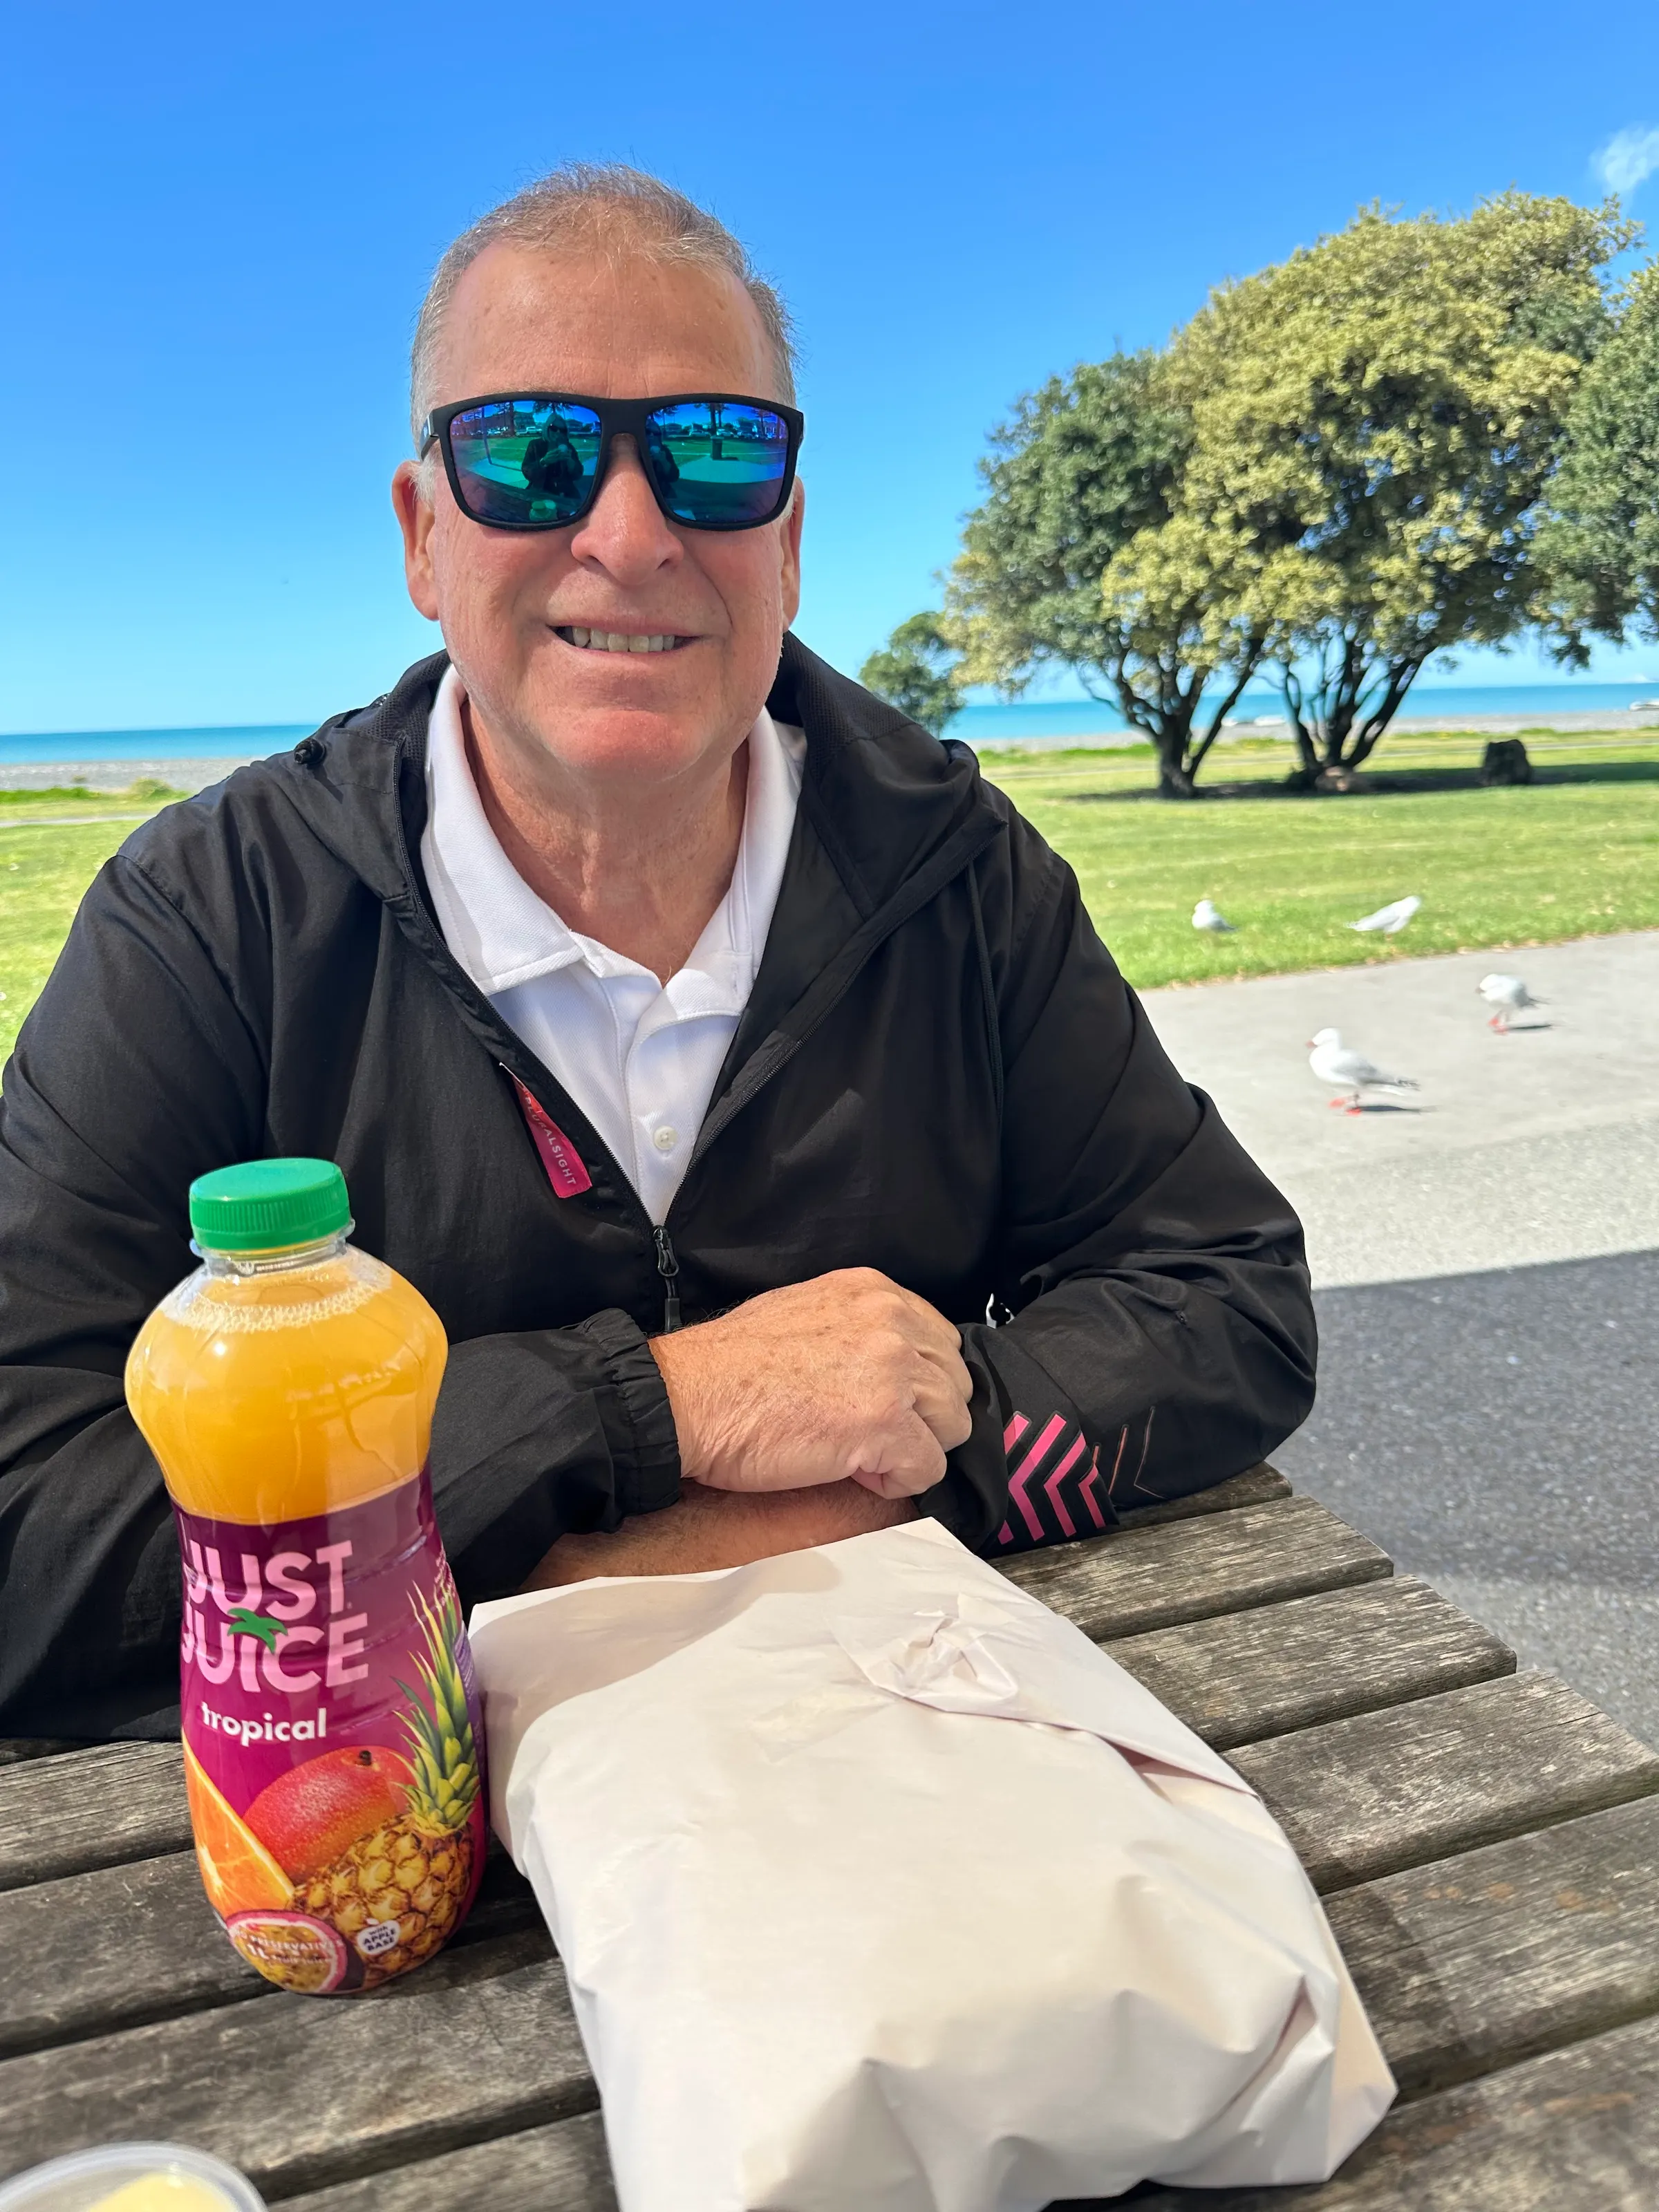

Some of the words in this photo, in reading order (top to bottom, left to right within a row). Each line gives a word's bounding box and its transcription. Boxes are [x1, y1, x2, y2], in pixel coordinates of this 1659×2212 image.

[525, 1096, 577, 1185] PLURALSIGHT
[182, 1539, 353, 1621] JUST
[181, 1601, 368, 1693] JUICE
[200, 1701, 327, 1747] tropical
[363, 1929, 395, 1945] APPLE
[367, 1938, 394, 1951] BASE
